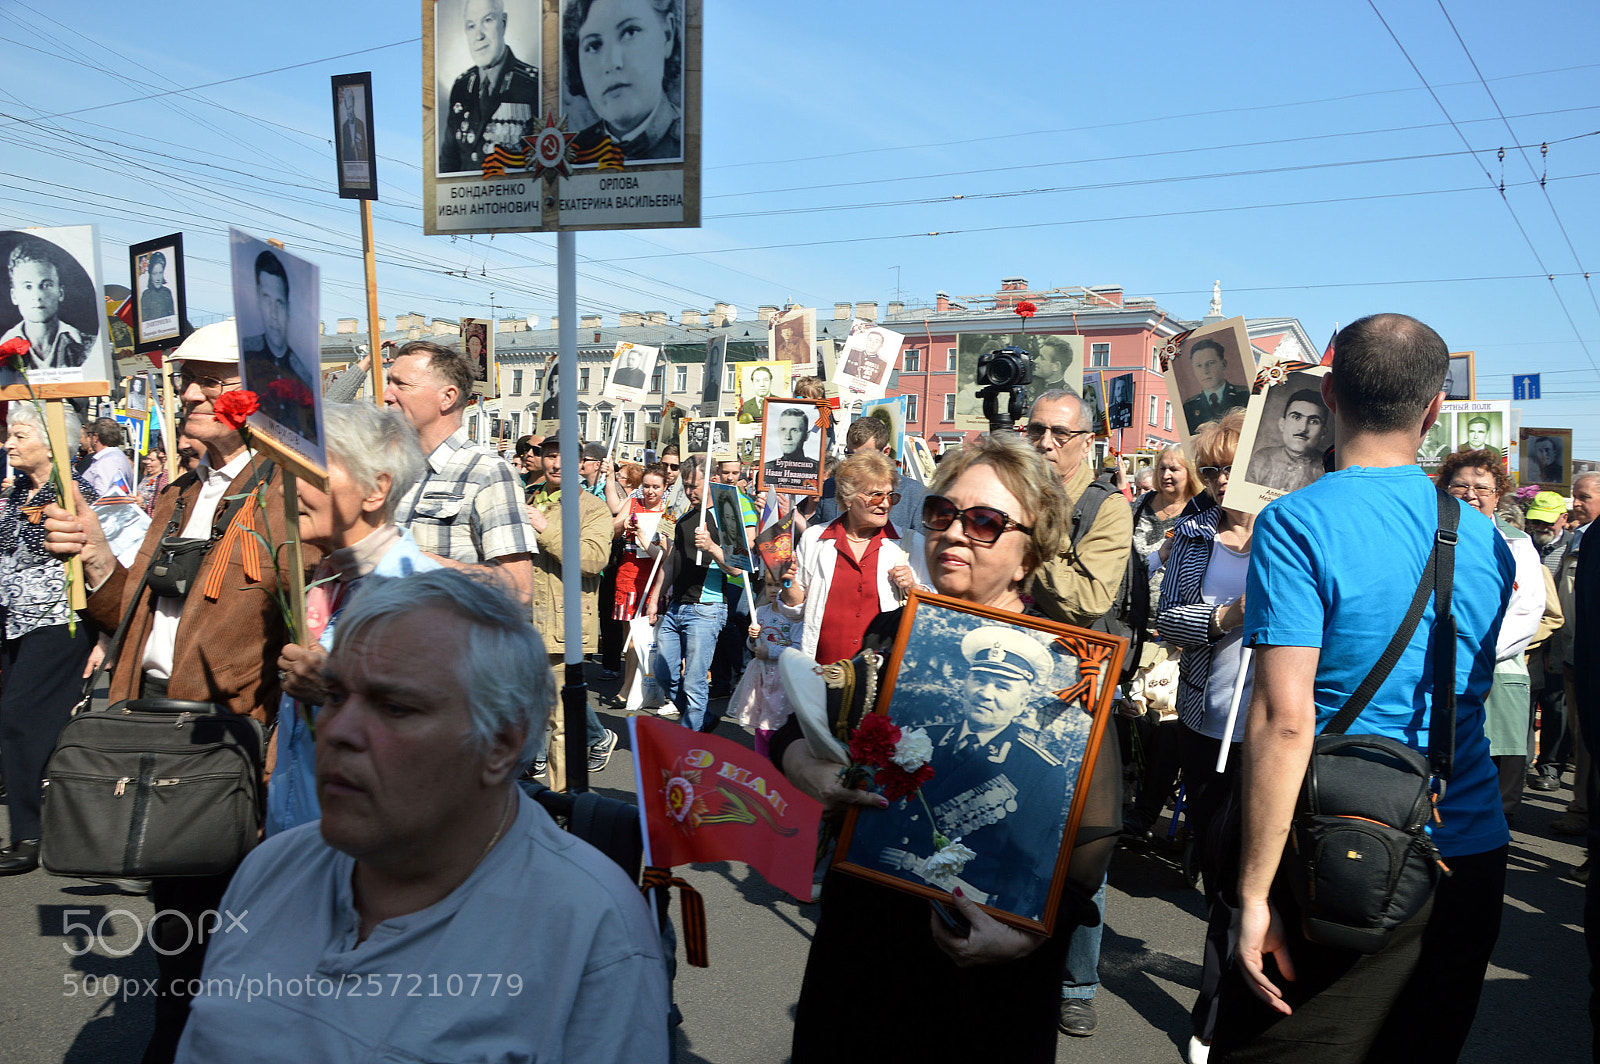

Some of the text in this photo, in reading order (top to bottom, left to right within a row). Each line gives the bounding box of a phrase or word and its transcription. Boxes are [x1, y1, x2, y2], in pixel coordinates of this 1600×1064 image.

[600, 177, 640, 190] ОРЛОВА
[451, 183, 526, 199] БОНДАРЕНКО
[438, 200, 540, 216] ИВАН АНТОНОВИЧ
[559, 194, 684, 211] ЕКАТЕРИНА ВАСИЛЬЕВНА
[1440, 403, 1492, 411] ЕРТНЫЙ ПОЛК
[776, 458, 813, 468] Бурименко
[784, 470, 818, 479] Иванович
[684, 749, 715, 768] 9
[716, 761, 788, 817] МАЯ
